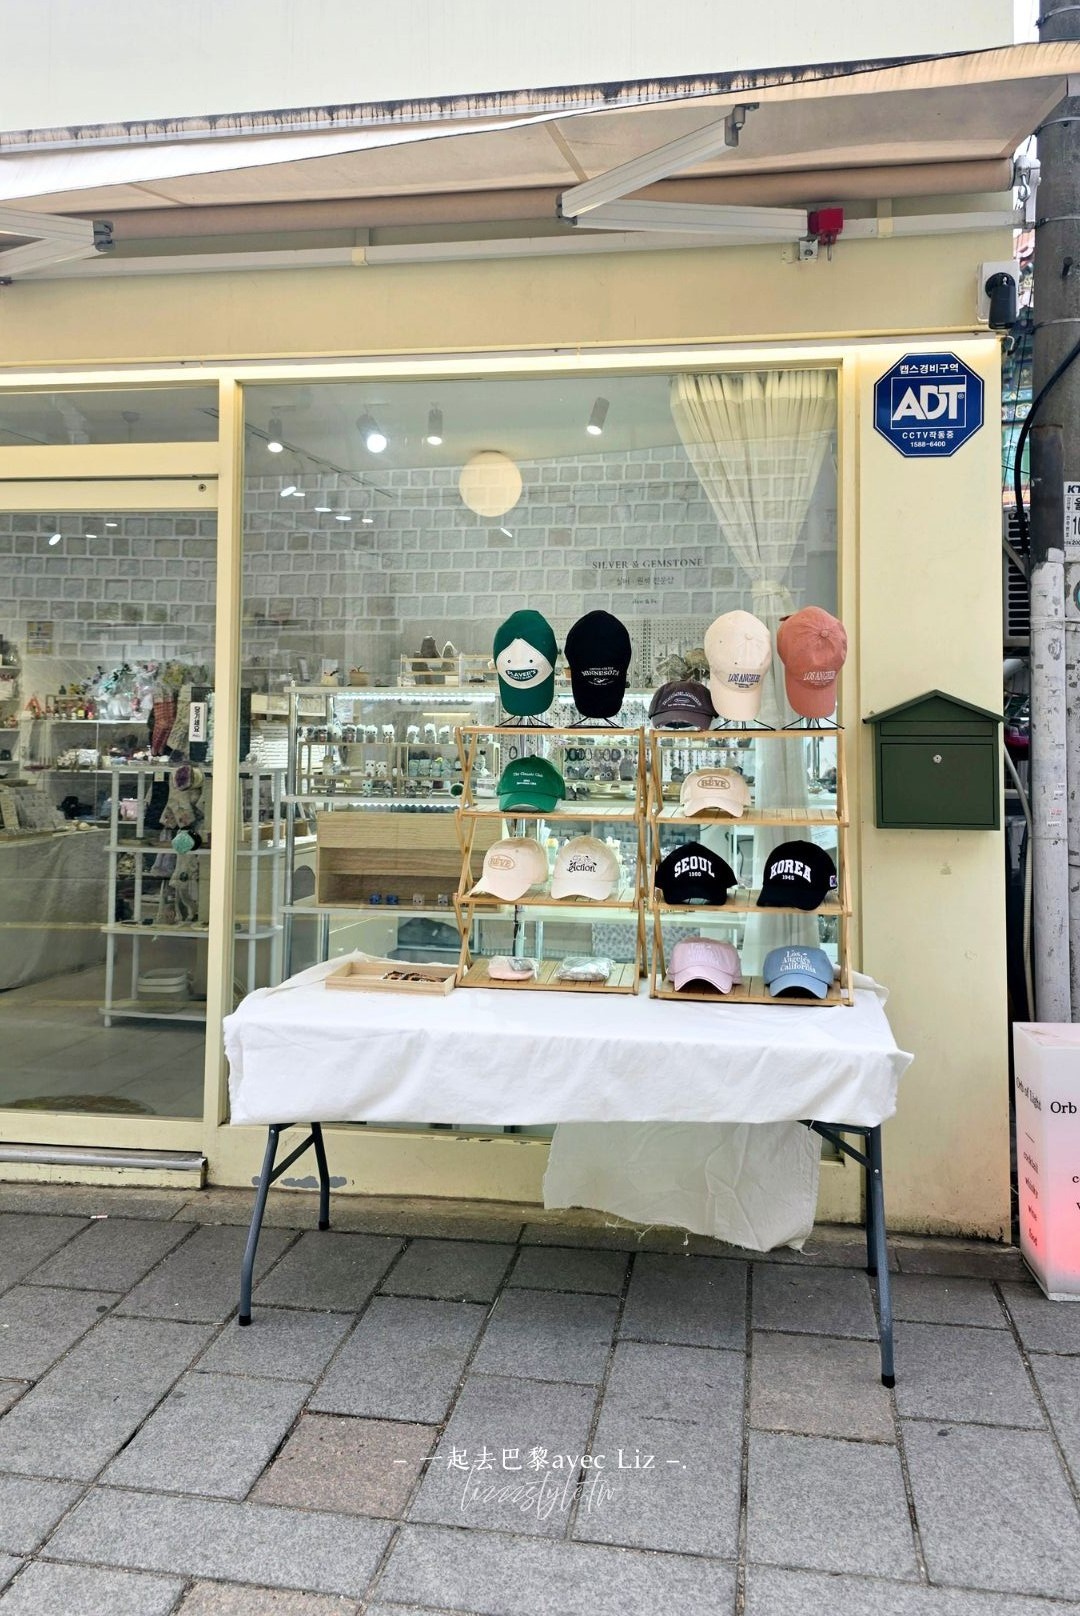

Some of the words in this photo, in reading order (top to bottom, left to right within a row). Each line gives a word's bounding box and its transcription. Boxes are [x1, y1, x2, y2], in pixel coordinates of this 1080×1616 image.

[900, 363, 959, 374] 캡스경비구역
[892, 383, 966, 421] ADT
[592, 560, 628, 569] SILVER
[633, 560, 639, 568] &
[642, 558, 703, 568] GEMSTONE
[674, 855, 716, 878] SEOUL
[769, 859, 812, 884] KOREA
[1050, 1101, 1077, 1114] Orb
